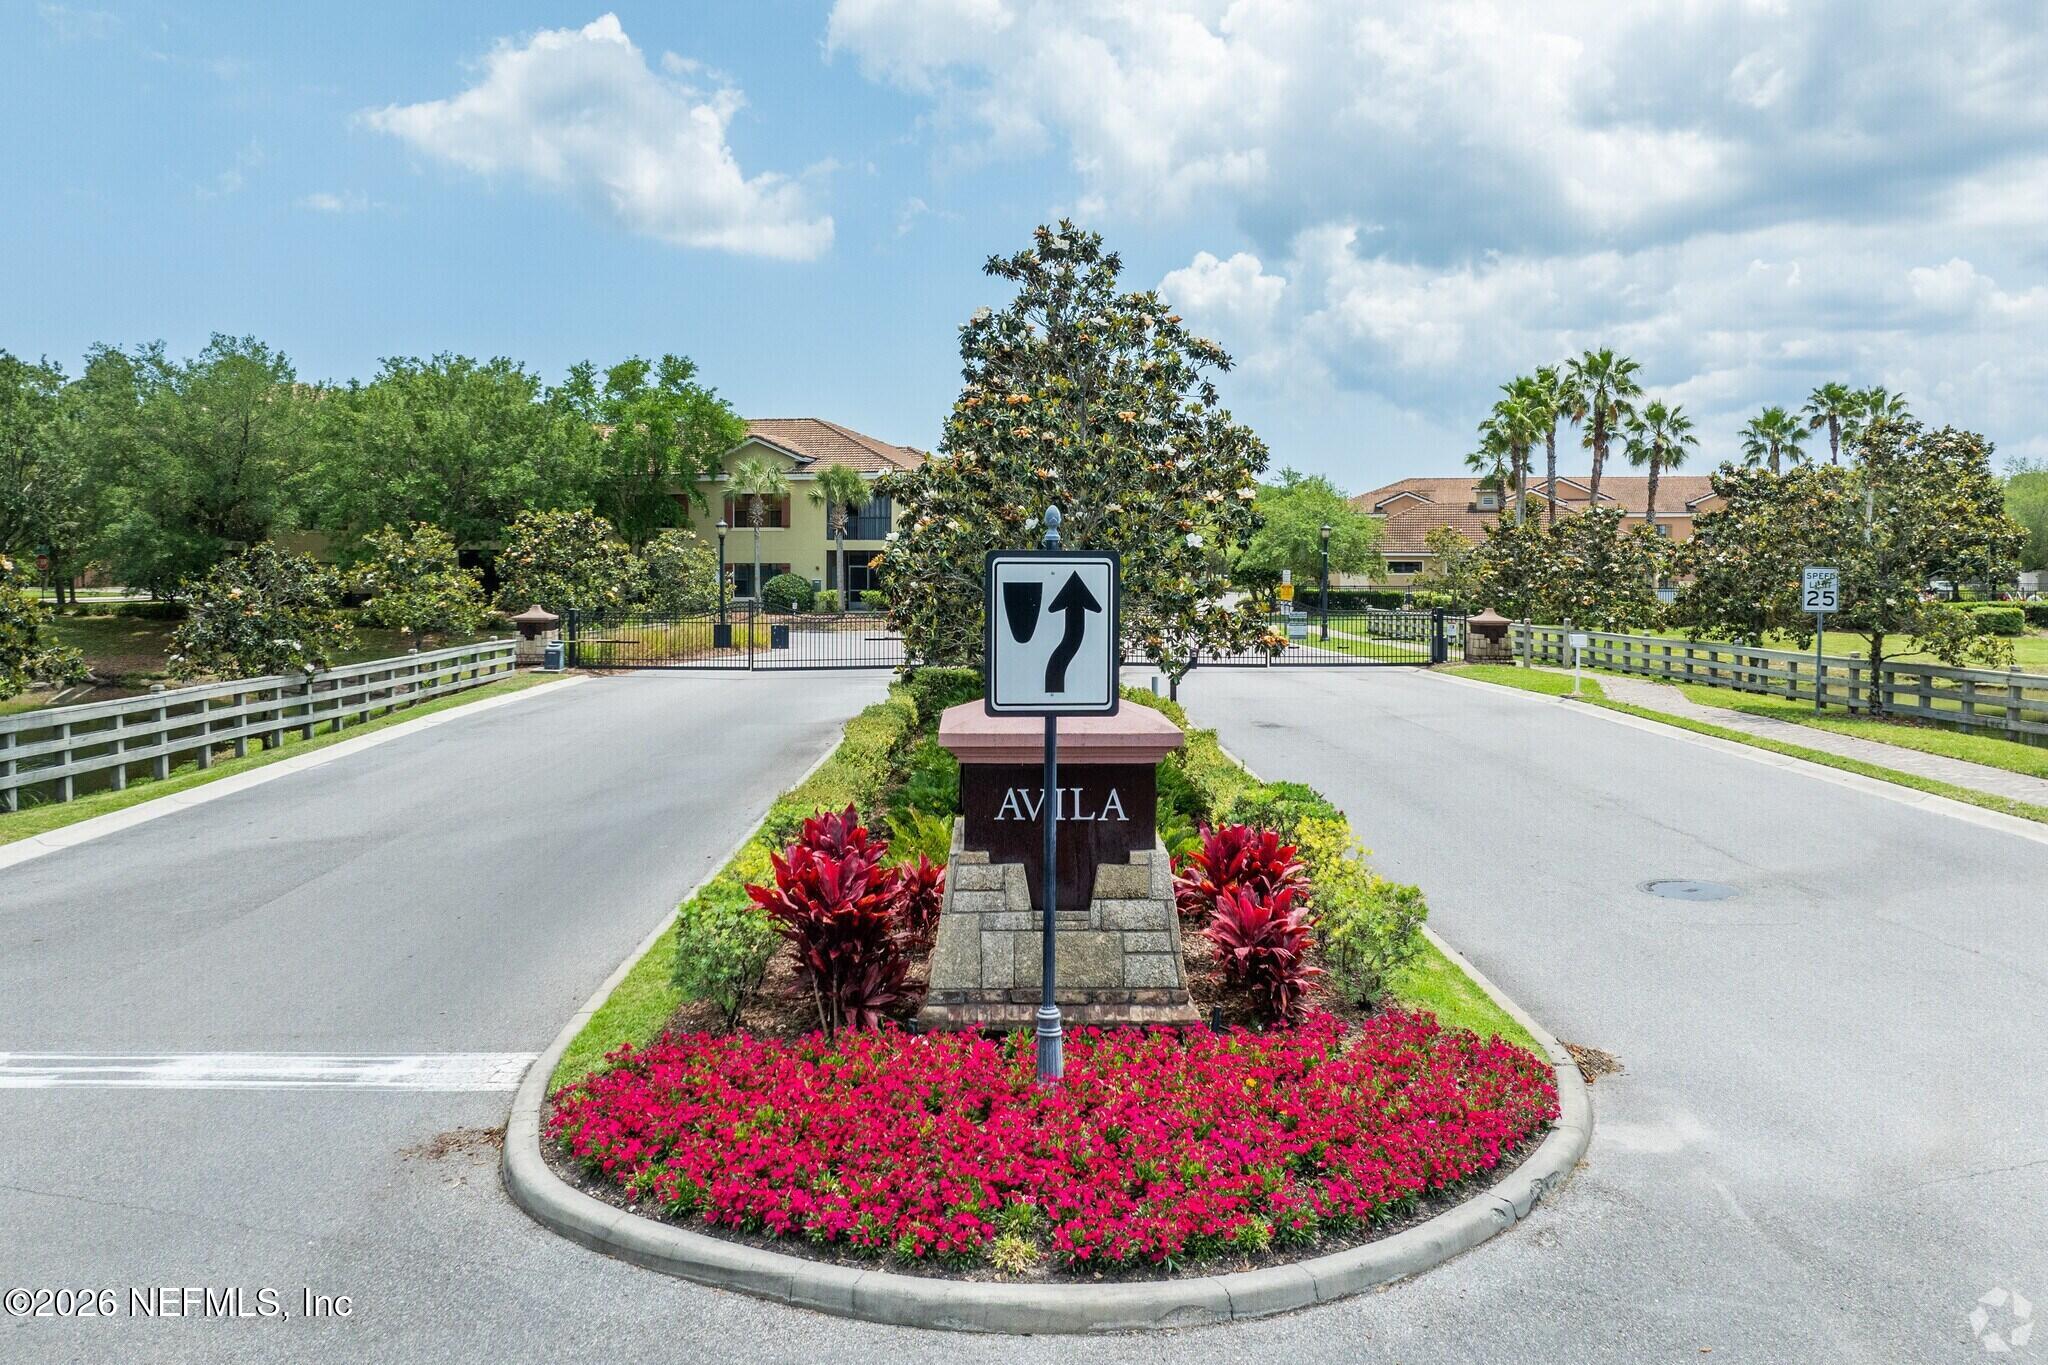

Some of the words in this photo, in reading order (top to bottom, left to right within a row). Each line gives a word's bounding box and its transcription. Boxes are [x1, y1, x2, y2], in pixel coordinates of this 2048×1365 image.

[1806, 572, 1836, 580] SPEED
[1806, 590, 1835, 607] 25
[993, 786, 1130, 822] AVILA
